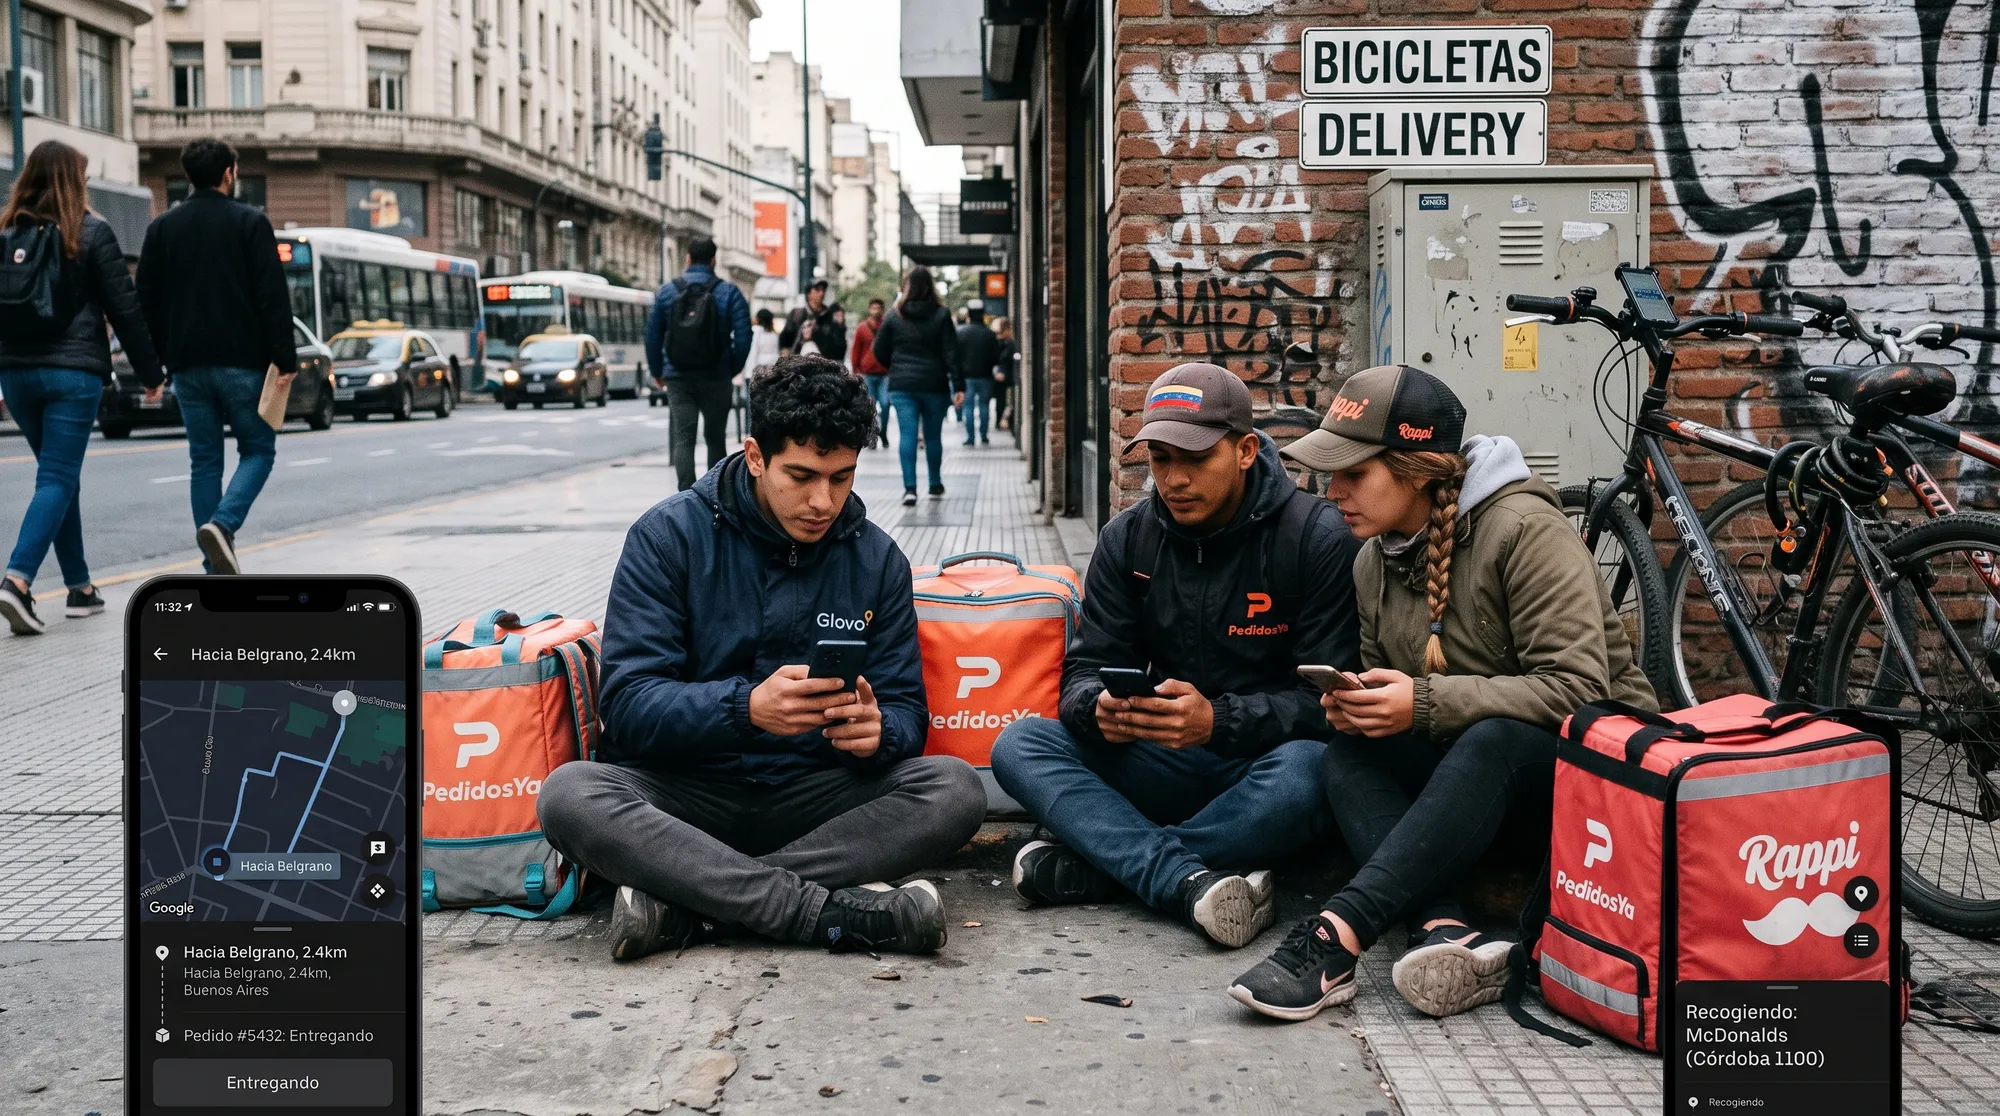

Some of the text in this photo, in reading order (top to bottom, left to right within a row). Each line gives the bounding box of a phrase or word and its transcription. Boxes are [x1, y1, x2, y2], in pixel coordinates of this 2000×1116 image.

[1314, 38, 1542, 85] BICICLETAS
[1318, 112, 1526, 157] DELIVERY
[1398, 422, 1434, 441] Rappi
[154, 602, 182, 612] 11:32
[816, 612, 865, 631] Glovo
[191, 647, 356, 665] Hacia Belgrano, 2.4km
[1738, 820, 1861, 891] Rappi
[241, 860, 332, 875] Hacia Belgrano
[1556, 869, 1635, 921] PedidosYa
[149, 901, 194, 916] Google
[184, 945, 347, 962] Hacia Belgrano, 2.4km
[184, 966, 332, 982] Hacia Belgrano, 2.4km,
[184, 984, 269, 996] Buenos Aires
[1686, 1003, 1798, 1022] Recogiendo:
[184, 1028, 374, 1046] Pedido #5432: Entregando
[1686, 1026, 1788, 1043] McDonalds
[1686, 1049, 1825, 1069] (Córdoba 1100)
[227, 1075, 319, 1093] Entregando
[1708, 1097, 1765, 1109] Recogiendo
